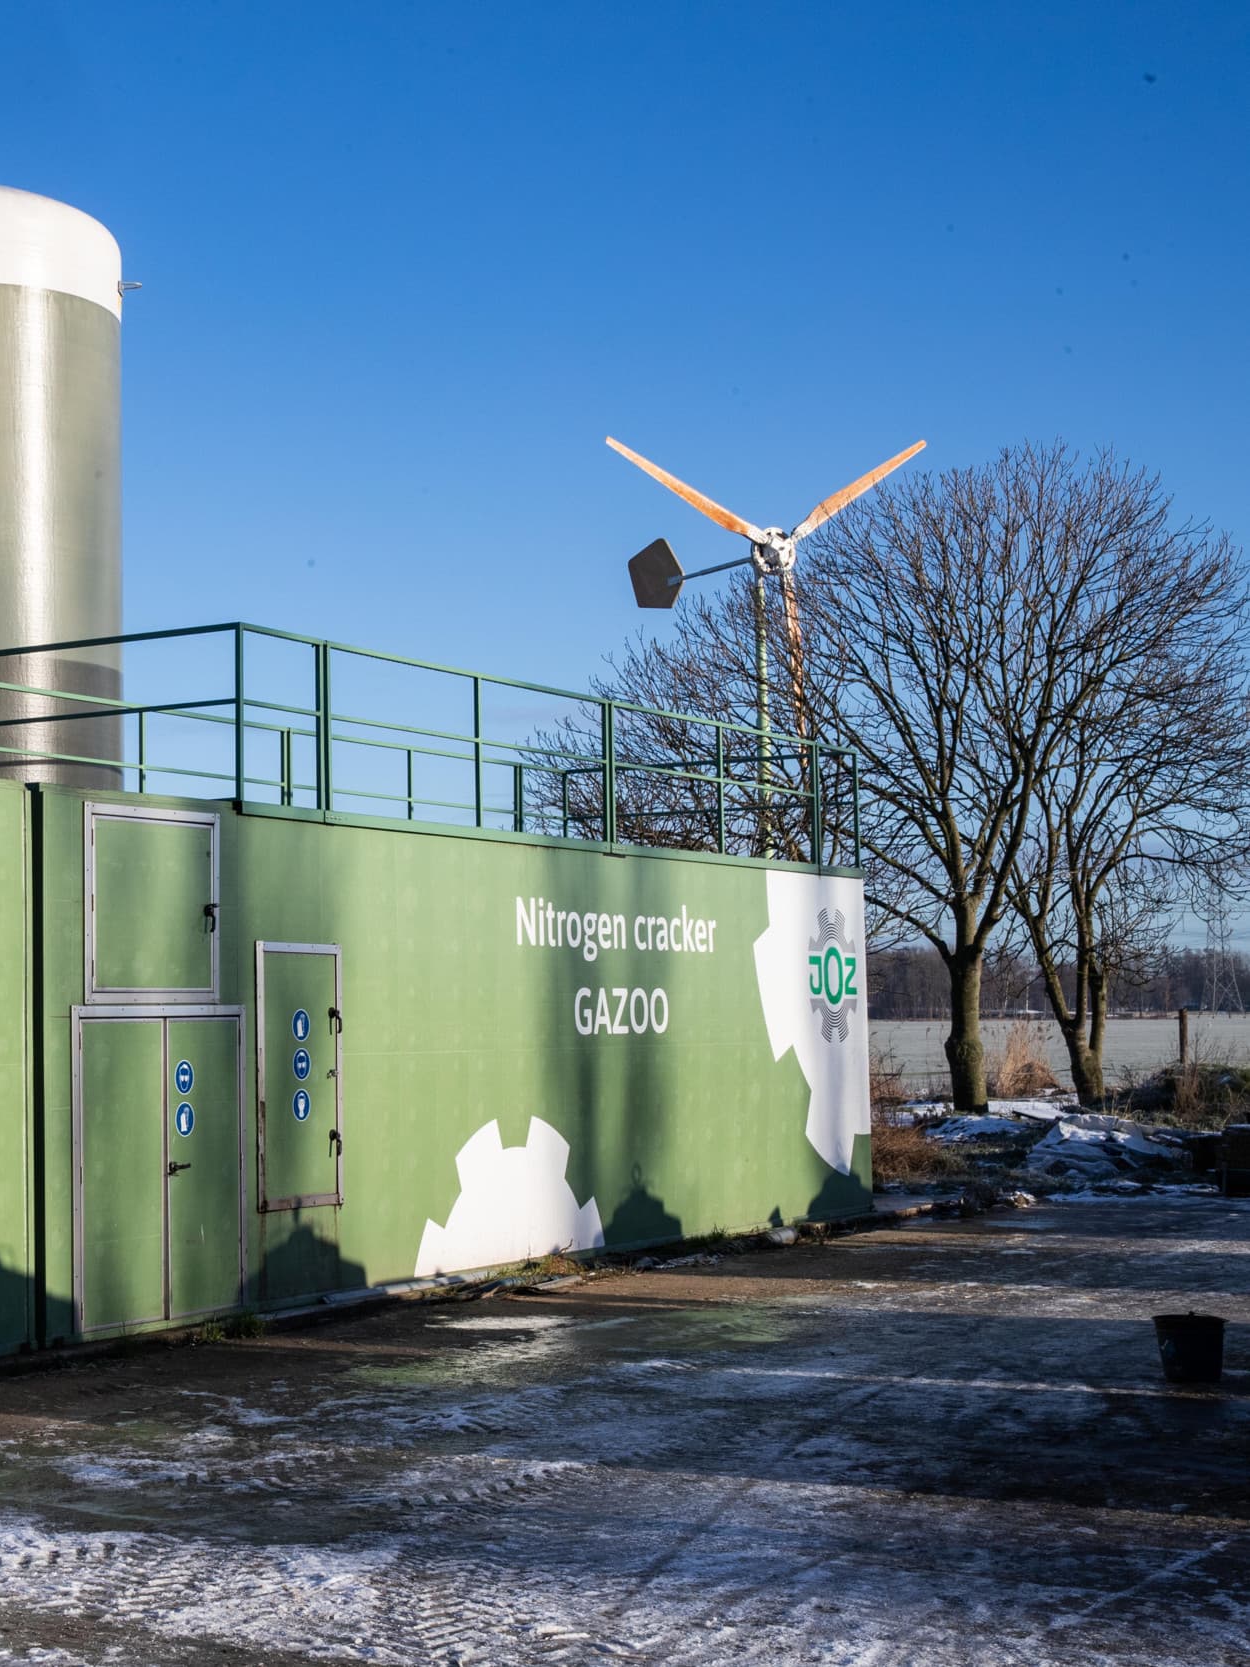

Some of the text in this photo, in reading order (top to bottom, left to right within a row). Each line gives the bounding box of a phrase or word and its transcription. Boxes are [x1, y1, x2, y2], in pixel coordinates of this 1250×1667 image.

[515, 895, 717, 962] Nitrogen cracker
[808, 946, 858, 1006] JOZ
[574, 986, 670, 1036] GAZOO
